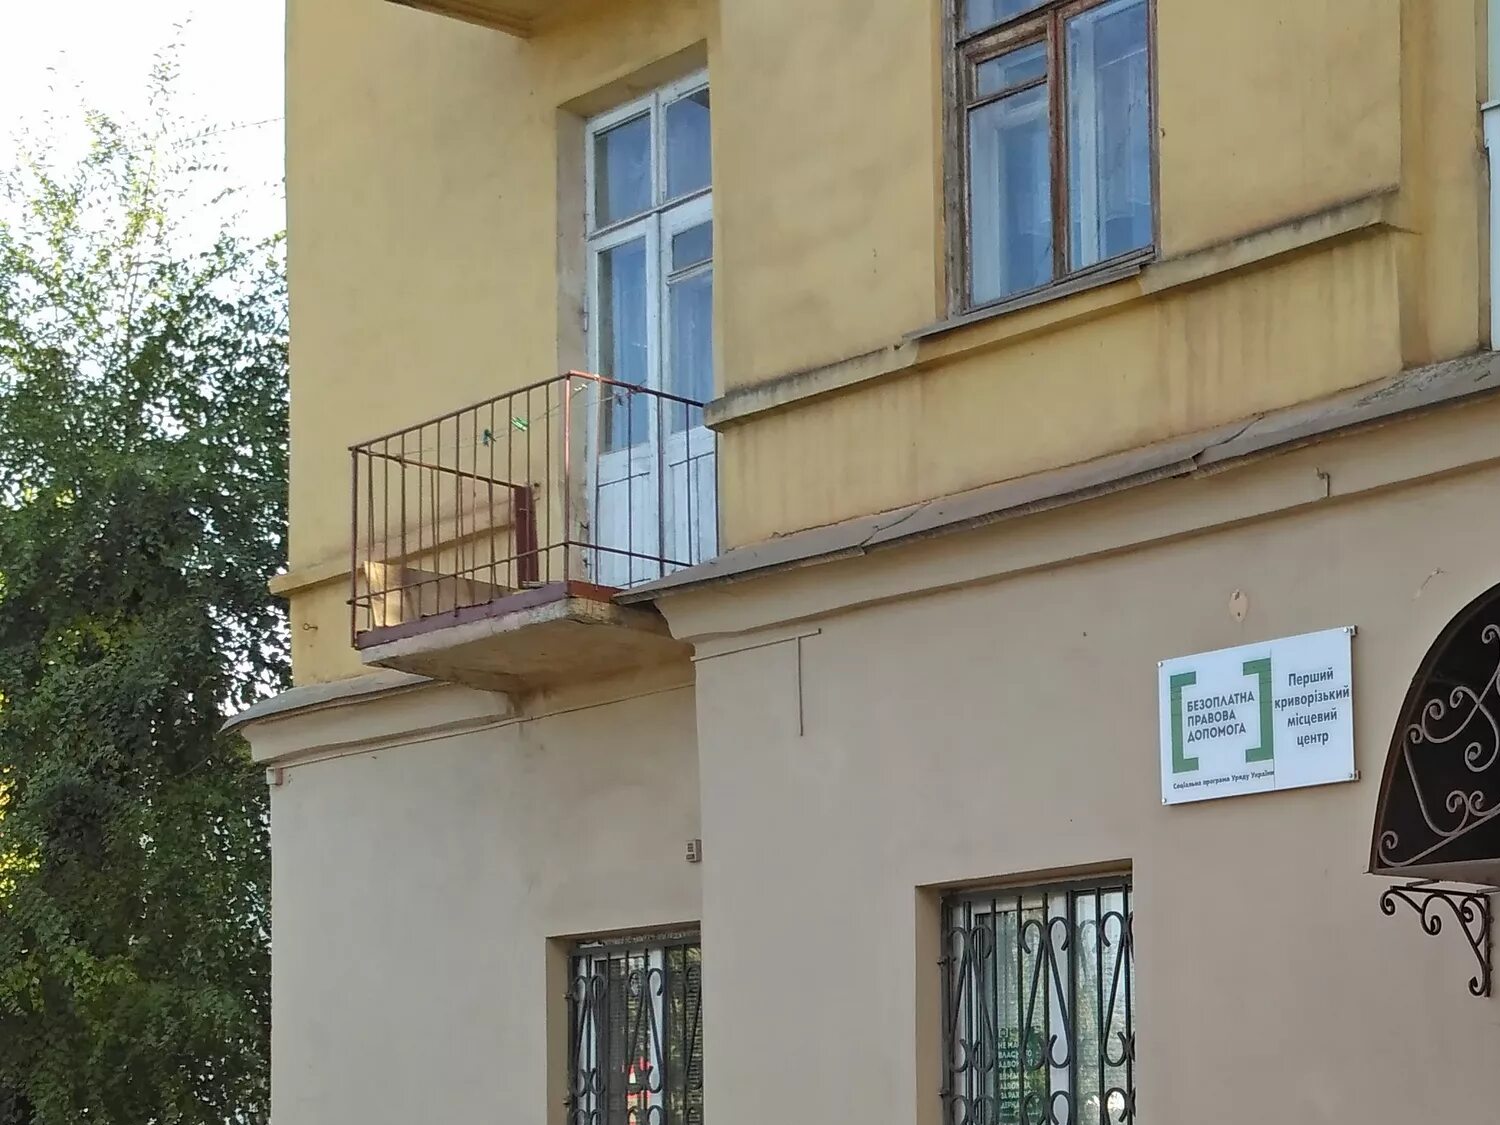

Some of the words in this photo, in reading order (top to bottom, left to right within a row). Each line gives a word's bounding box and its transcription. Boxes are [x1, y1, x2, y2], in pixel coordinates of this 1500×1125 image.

[1288, 666, 1334, 688] Перший
[1187, 691, 1255, 712] БЕЗОПЛАТНА
[1274, 684, 1350, 711] криворізький
[1187, 709, 1237, 727] ПРАВОВА
[1287, 707, 1338, 727] місцевий
[1187, 722, 1247, 743] ДОПОМОГА
[1296, 732, 1329, 747] центр
